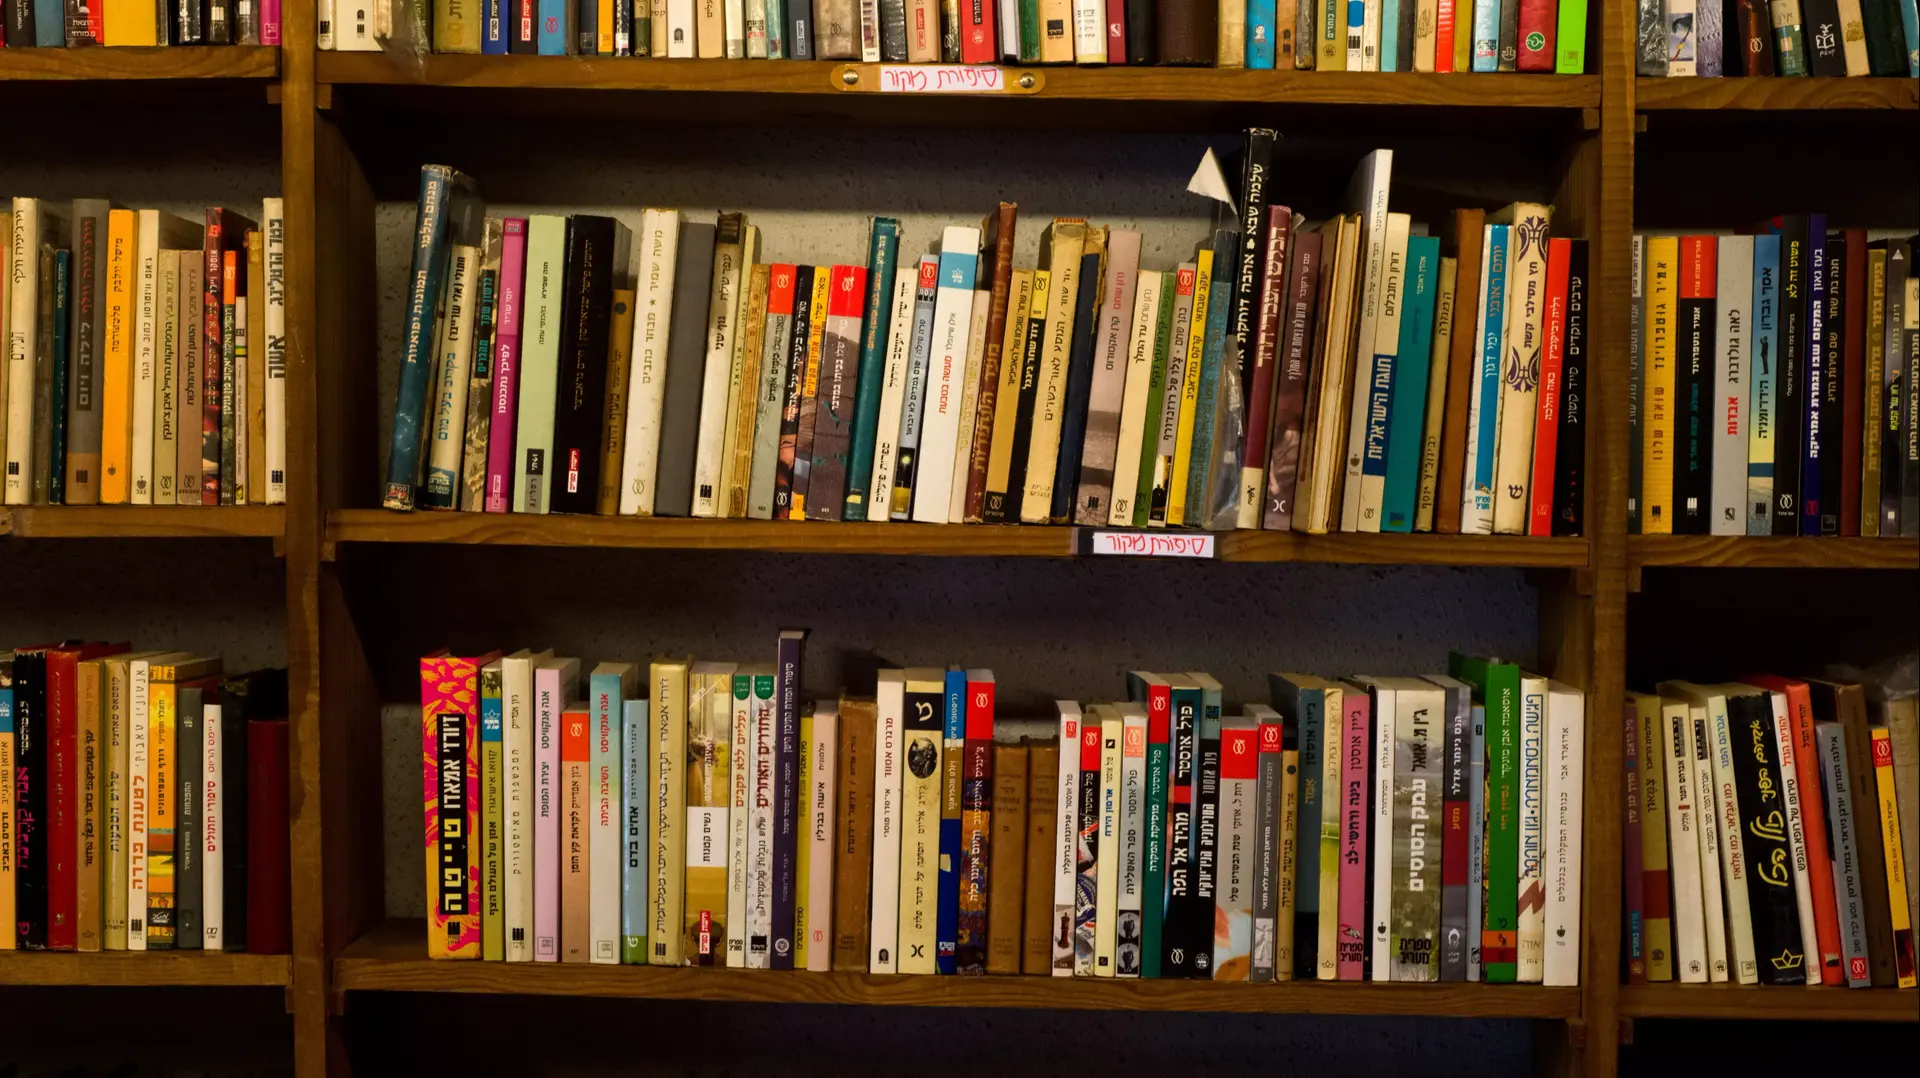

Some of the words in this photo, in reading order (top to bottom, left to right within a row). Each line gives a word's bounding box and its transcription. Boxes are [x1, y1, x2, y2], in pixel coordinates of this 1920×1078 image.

[884, 70, 927, 91] מקור
[937, 68, 997, 88] סיפורת
[1248, 164, 1263, 202] שלמה
[423, 181, 436, 214] מנחם
[268, 219, 284, 246] פטר
[420, 218, 434, 249] תלמי
[1248, 205, 1260, 235] שבא
[652, 230, 663, 257] משה
[1789, 241, 1799, 267] פשוט
[14, 259, 25, 283] וולף
[454, 257, 465, 280] חתולי
[1388, 252, 1400, 275] דורון
[1492, 245, 1504, 272] יותם
[1527, 261, 1538, 276] חץ
[1812, 249, 1823, 267] בעז
[267, 251, 284, 306] הרטלינג
[649, 262, 661, 292] שמיר
[1198, 271, 1208, 289] יעקב
[1241, 254, 1256, 292] אהבה
[1760, 268, 1772, 295] אסף
[1788, 269, 1798, 281] זה
[1812, 269, 1824, 291] גאון
[79, 285, 92, 314] וולף
[412, 270, 427, 315] תמונות
[481, 278, 493, 302] גרשון
[1385, 278, 1398, 317] רוזנבלום
[1488, 276, 1502, 317] ראובני
[1571, 276, 1582, 312] ערבים
[1786, 284, 1798, 298] לא
[480, 306, 492, 326] שקד
[503, 304, 511, 324] שריד
[1195, 294, 1206, 322] שבתאי
[1550, 296, 1560, 318] דליה
[1759, 298, 1772, 330] גברון
[1810, 300, 1821, 340] המקום
[646, 313, 656, 343] מבחר
[917, 319, 926, 334] שרה
[1237, 299, 1252, 343] דוחקת
[1726, 310, 1740, 332] לאה
[78, 322, 91, 365] לילה
[407, 317, 422, 363] יפואיות
[914, 336, 925, 355] שילה
[1488, 332, 1498, 350] ימי
[1523, 323, 1536, 348] קשת
[1548, 321, 1560, 360] רביקוביץ
[1569, 316, 1581, 355] רוקדים
[268, 335, 285, 379] אשה
[477, 340, 488, 372] מהגרים
[499, 344, 511, 375] לפיכך
[642, 349, 653, 384] כתבים
[913, 360, 921, 375] שום
[942, 356, 952, 380] מעשה
[1485, 353, 1498, 377] דגון
[1727, 338, 1740, 383] גולדברג
[1810, 343, 1820, 368] שבו
[1375, 358, 1392, 390] תוגת
[1546, 372, 1556, 391] באה
[1568, 367, 1578, 389] סייד
[79, 375, 90, 405] ויום
[498, 377, 508, 413] נתכנסנו
[910, 376, 920, 400] גמדים
[938, 385, 950, 414] בטבעת
[1810, 371, 1820, 407] נגמרת
[440, 391, 453, 415] בעל
[907, 402, 917, 414] לא
[1543, 394, 1554, 420] והלכה
[1566, 393, 1578, 423] קשוע
[1726, 397, 1738, 435] אבדות
[437, 419, 448, 440] מום
[906, 416, 916, 435] יבואו
[1368, 393, 1388, 461] הישראליות
[1809, 410, 1820, 458] אמריקה
[1106, 533, 1146, 553] מקור
[1149, 536, 1205, 555] סיפורת
[785, 663, 794, 686] סיפורי
[785, 687, 793, 710] המזרח
[734, 710, 746, 744] נעליים
[784, 712, 793, 734] התיכון
[1176, 705, 1192, 729] פול
[1453, 715, 1461, 734] הנס
[1778, 716, 1789, 744] יהודית
[600, 714, 609, 753] אנקוויסט
[783, 737, 792, 753] הישן
[884, 717, 893, 748] מרגרט
[733, 747, 745, 770] ללא
[884, 751, 892, 778] אטווד
[1177, 736, 1191, 778] אוסטר
[1349, 736, 1361, 770] אוסטן
[1411, 745, 1427, 772] אואל
[1452, 737, 1462, 765] גינתר
[1780, 747, 1791, 766] הנדל
[443, 760, 460, 809] אמאדו
[600, 766, 609, 795] השיבה
[734, 773, 745, 807] עקבים
[1126, 769, 1137, 786] פול
[1450, 768, 1461, 795] אדלר
[132, 776, 145, 833] לטענת
[206, 781, 216, 811] סיפורי
[816, 782, 825, 809] אישה
[1127, 788, 1136, 817] אוסטר
[1348, 781, 1360, 806] בינה
[1411, 779, 1430, 820] עמק
[1786, 779, 1797, 805] טירופו
[600, 797, 609, 826] הביתה
[629, 807, 638, 836] אחים
[703, 812, 711, 832] נשים
[1451, 808, 1460, 830] מסע
[1789, 808, 1798, 821] של
[206, 815, 216, 851] חתולים
[815, 812, 825, 841] בברלין
[1126, 829, 1136, 849] ספר
[1175, 812, 1189, 843] מהיד
[1791, 823, 1801, 844] רופא
[628, 840, 638, 867] בדם
[702, 835, 712, 862] קטנות
[1172, 847, 1188, 865] אל
[1409, 824, 1425, 891] הסוסים
[1795, 847, 1806, 871] הנפש
[133, 842, 144, 890] פררה
[1125, 851, 1136, 895] האשליות
[1172, 869, 1187, 896] הפה
[1400, 938, 1432, 950] ספרית
[1400, 951, 1430, 964] מעריב
